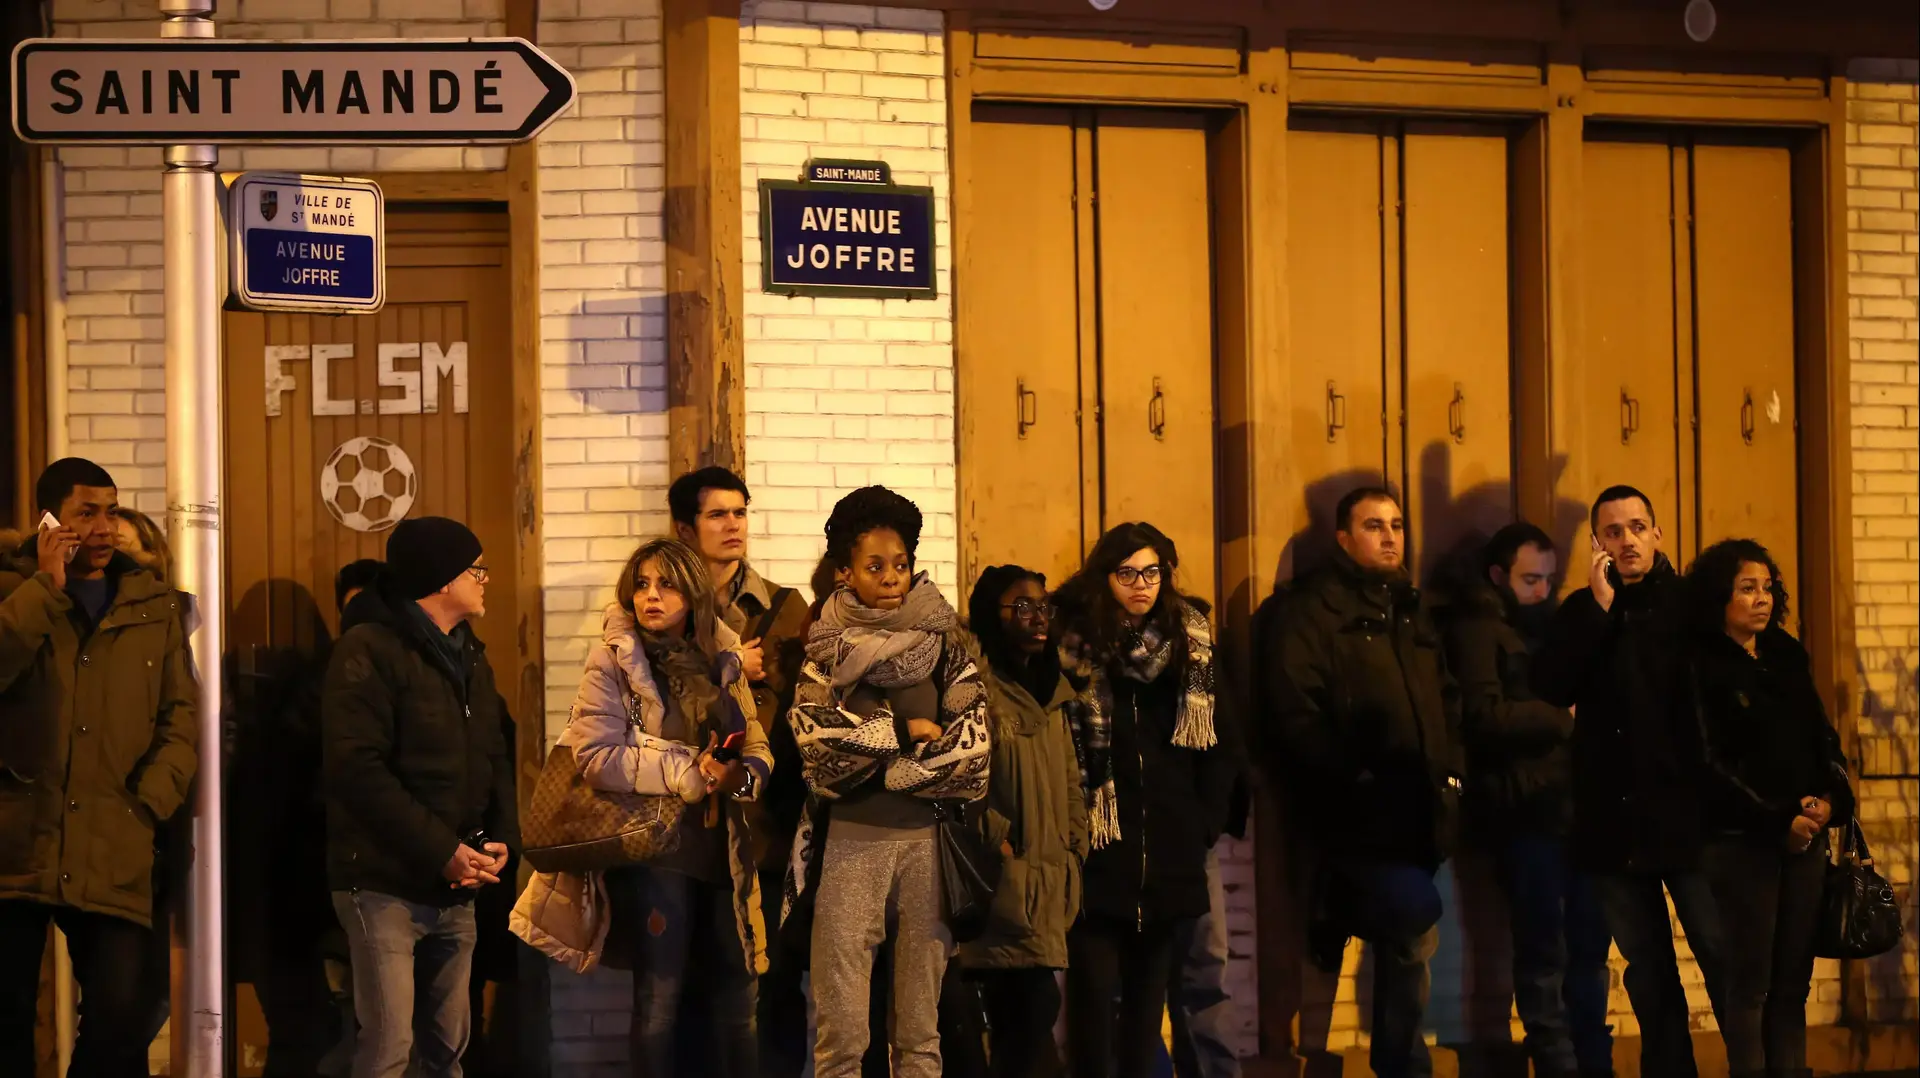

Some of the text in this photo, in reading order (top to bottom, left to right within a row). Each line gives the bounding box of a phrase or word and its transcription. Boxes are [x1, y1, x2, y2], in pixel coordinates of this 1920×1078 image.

[50, 60, 504, 115] SAINT MANDÉ
[816, 167, 881, 182] SAINT-MANDÉ
[295, 194, 352, 209] VILLE DE
[312, 212, 355, 227] MANDÉ
[801, 207, 901, 235] AVENUE
[276, 241, 345, 261] AVENUE
[787, 243, 915, 273] JOFFRE
[282, 267, 340, 287] JOFFRE
